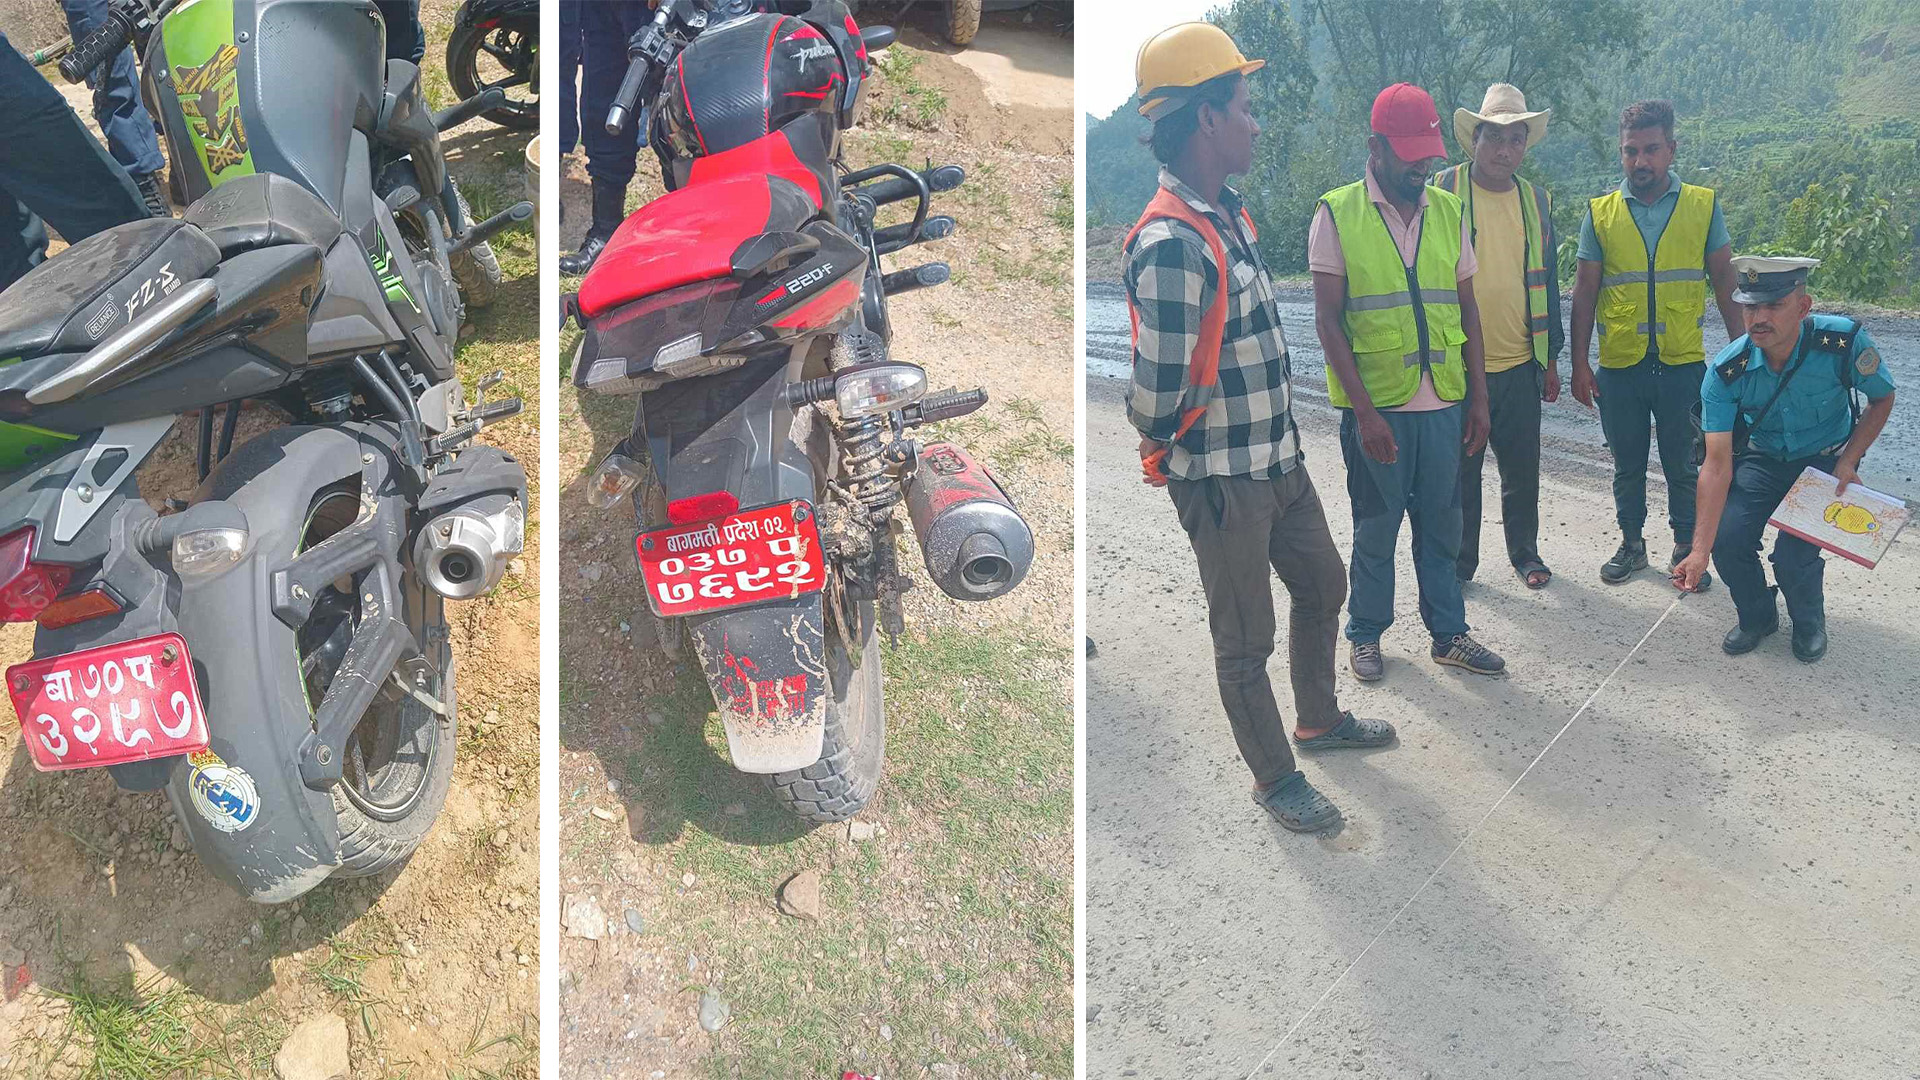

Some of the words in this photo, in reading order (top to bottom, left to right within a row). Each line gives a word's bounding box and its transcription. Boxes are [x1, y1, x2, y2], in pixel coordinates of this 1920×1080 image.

[90, 306, 115, 334] RELIANCE
[666, 523, 720, 553] बागमती
[659, 549, 746, 575] ०३७
[766, 535, 803, 557] प
